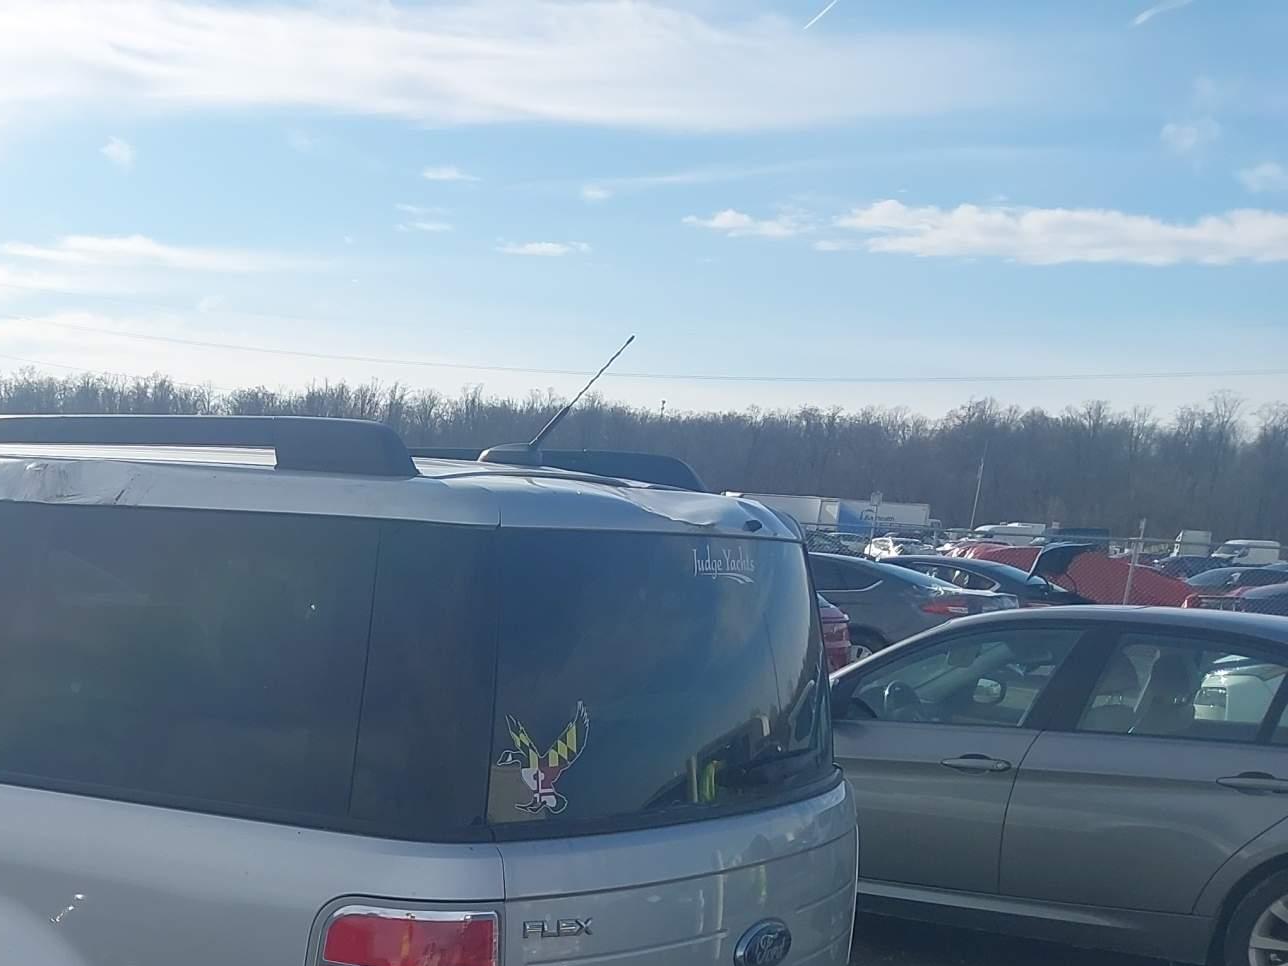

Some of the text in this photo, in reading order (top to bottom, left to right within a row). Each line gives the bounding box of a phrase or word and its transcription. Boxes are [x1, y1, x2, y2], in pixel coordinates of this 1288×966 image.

[692, 544, 754, 579] Judge Yachts
[522, 917, 593, 939] FLEX
[743, 925, 787, 966] Ford
